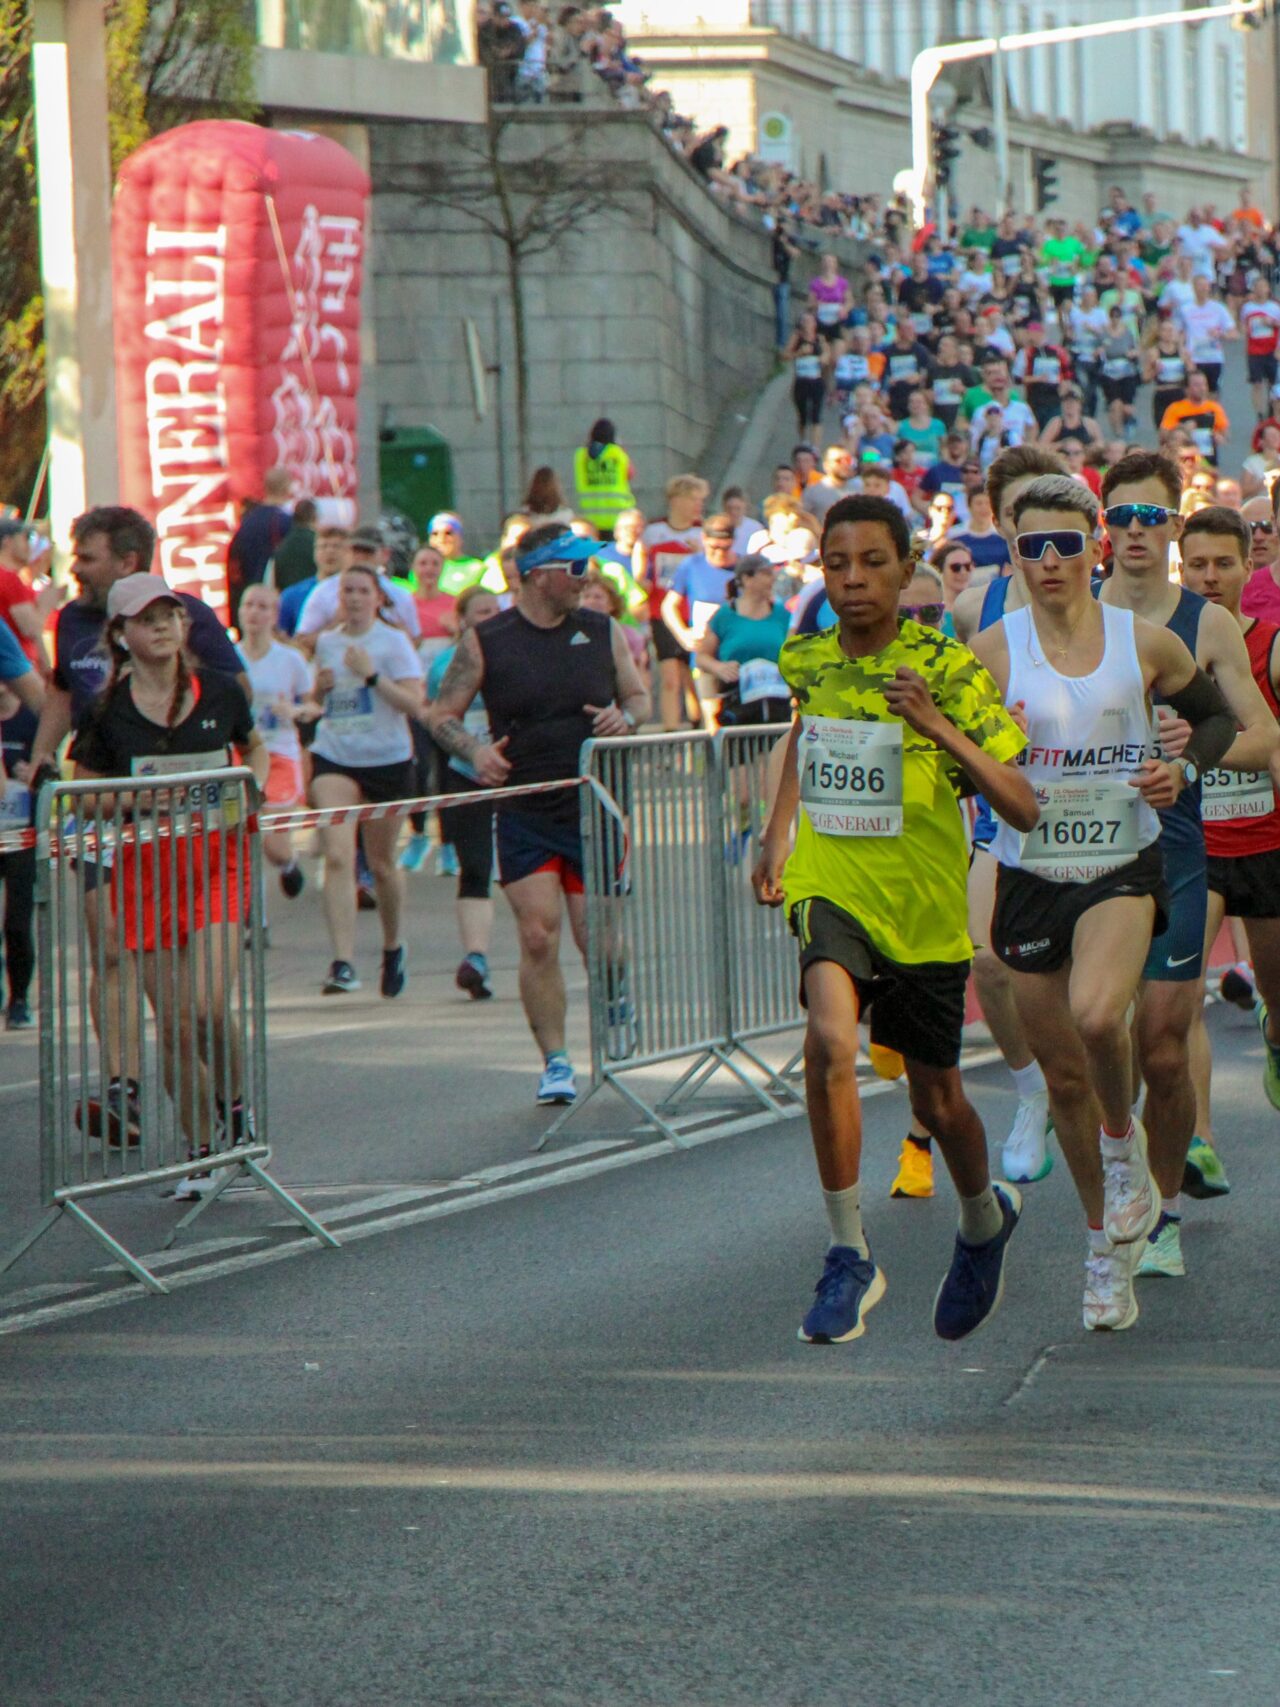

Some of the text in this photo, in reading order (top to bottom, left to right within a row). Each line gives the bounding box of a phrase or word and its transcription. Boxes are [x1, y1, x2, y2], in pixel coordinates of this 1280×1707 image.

[829, 750, 858, 760] Michael
[808, 760, 885, 793] 15986
[1203, 768, 1259, 787] 5515
[1063, 808, 1095, 817] Samuel
[1204, 800, 1266, 817] GENERALI
[819, 812, 891, 832] GENERALI
[1037, 820, 1121, 844] 16027
[1054, 865, 1119, 880] GENERA
